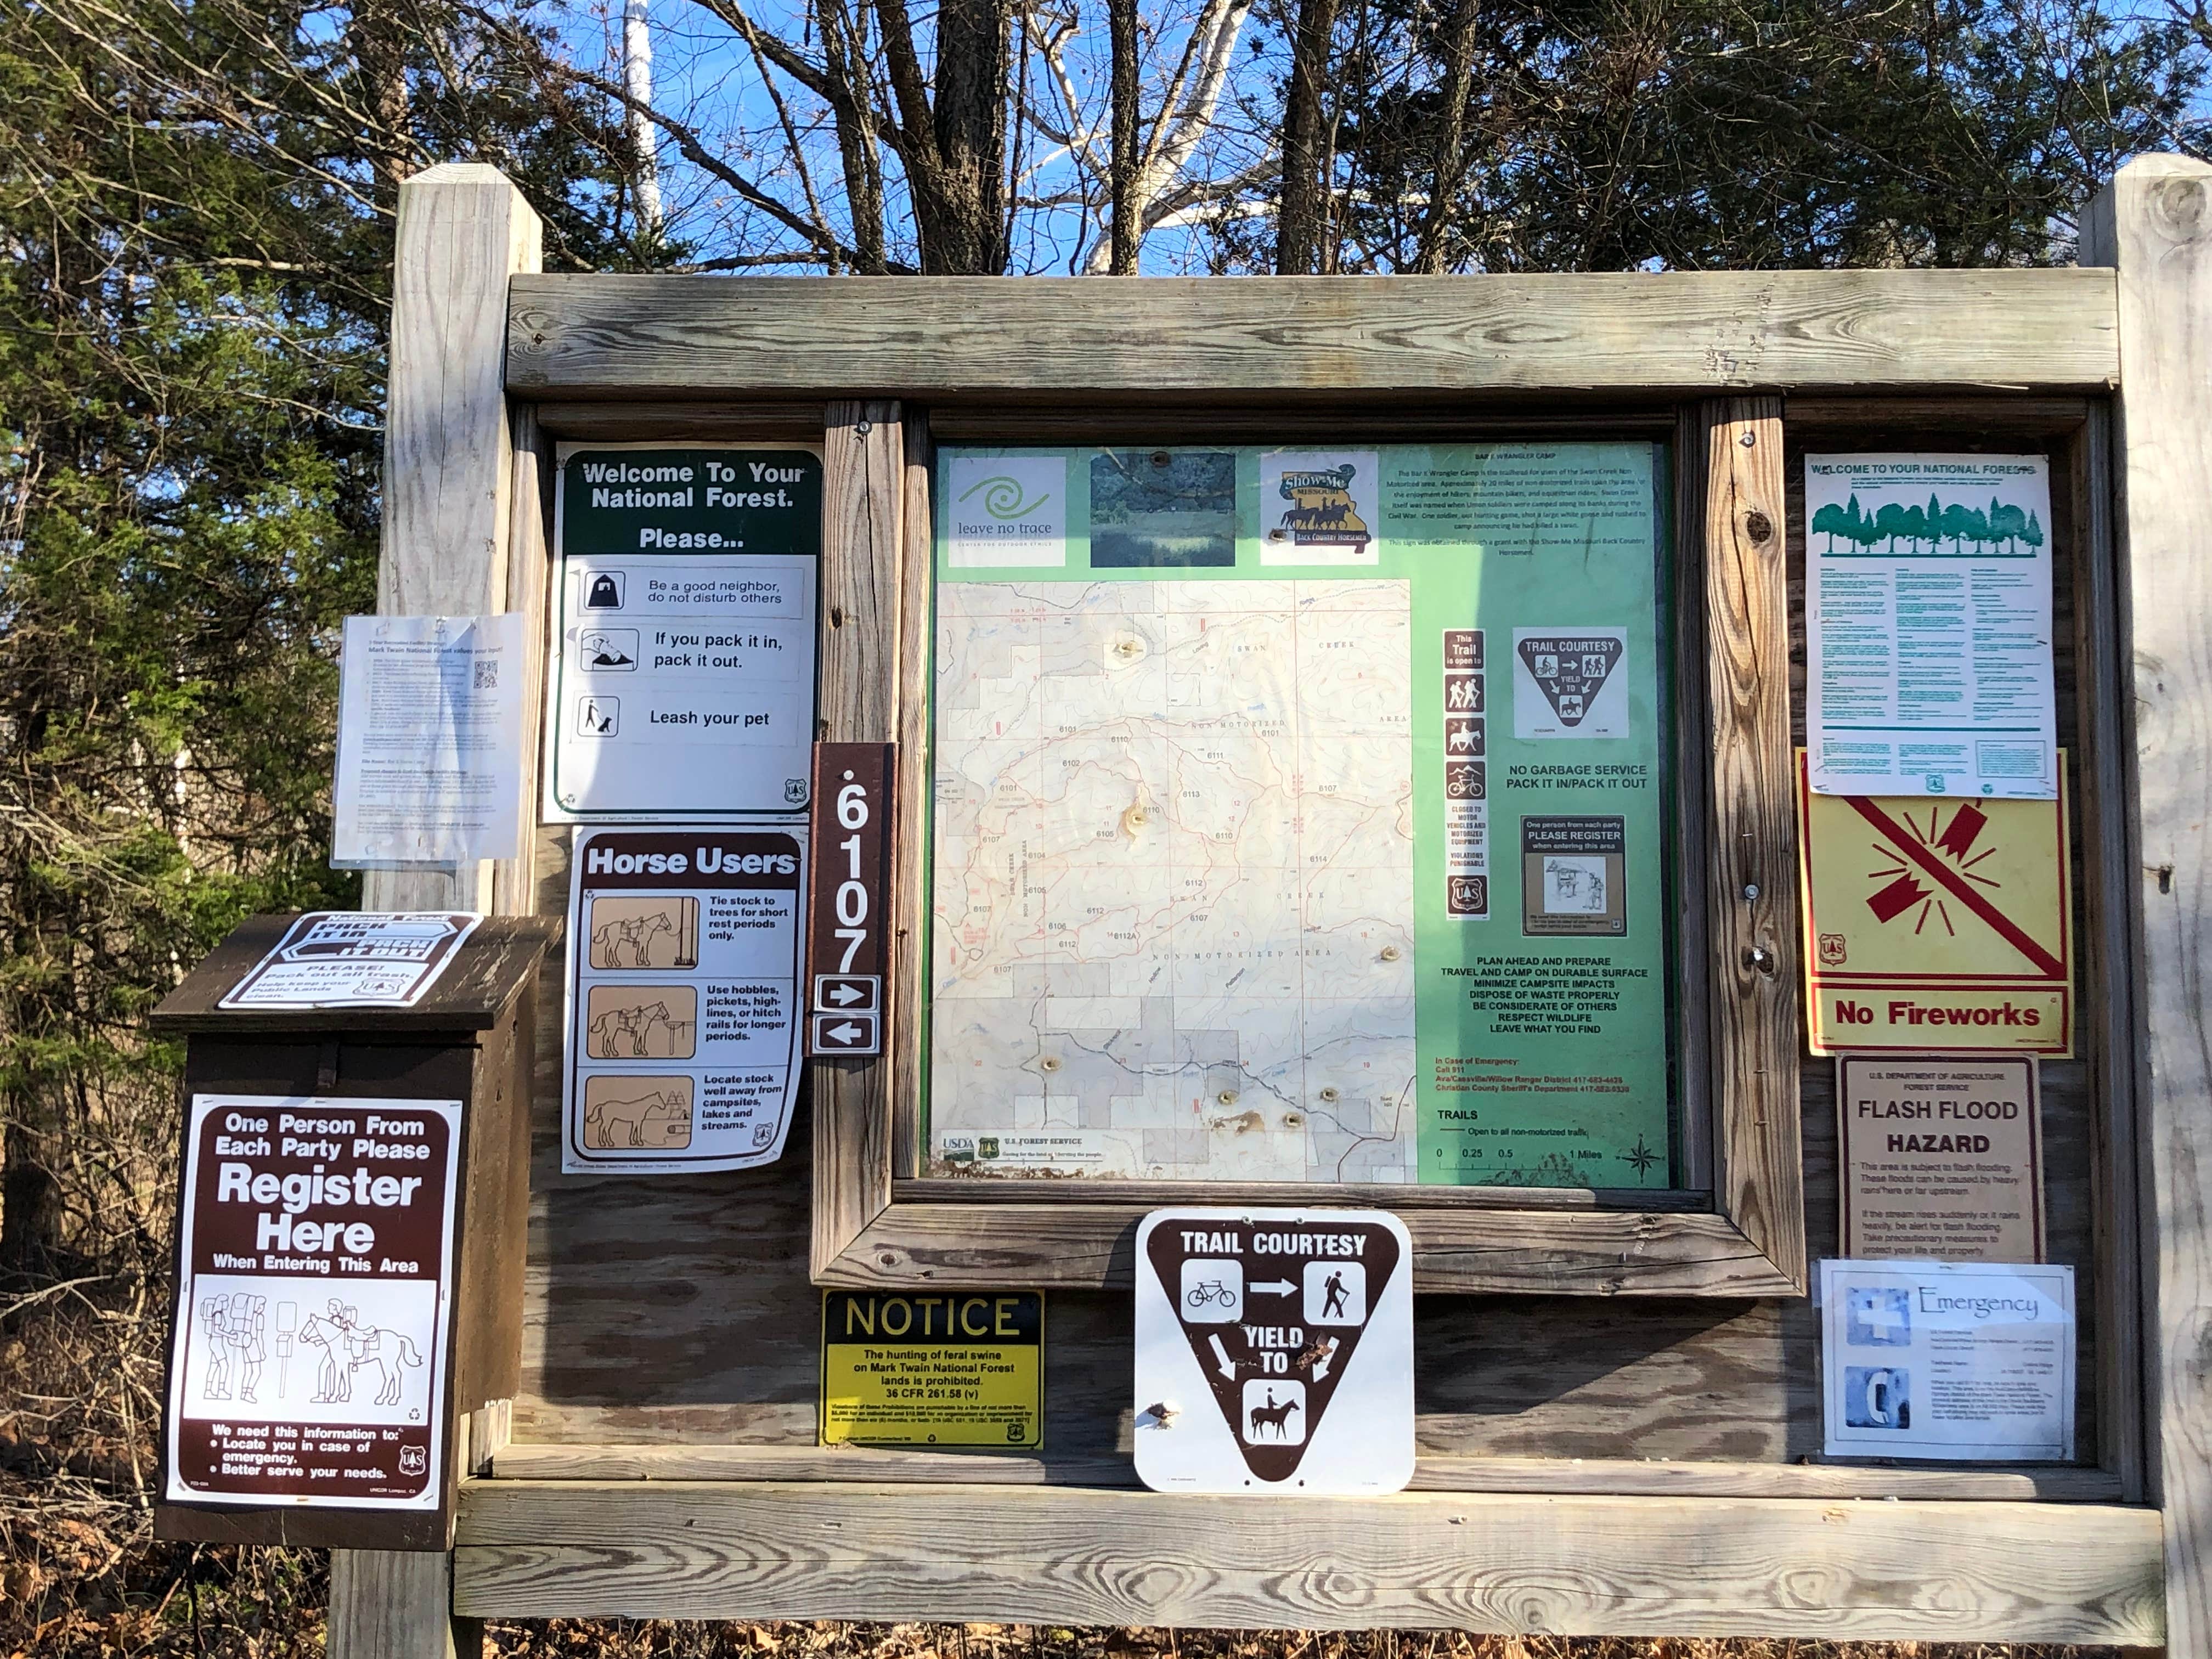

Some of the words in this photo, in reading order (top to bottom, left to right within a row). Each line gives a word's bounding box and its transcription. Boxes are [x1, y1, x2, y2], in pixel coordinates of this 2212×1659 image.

[584, 463, 693, 482] Welcome
[707, 463, 735, 481] To
[749, 463, 803, 482] Your
[1812, 465, 1869, 474] WELCOME
[1890, 465, 1920, 473] YOUR
[1924, 466, 1981, 474] NATIONAL
[592, 488, 693, 507] National
[707, 488, 793, 506] Forest.
[958, 522, 993, 533] leave
[997, 525, 1014, 533] no
[1019, 523, 1051, 533] trace
[640, 528, 743, 548] Please...
[650, 580, 667, 591] Be
[672, 583, 679, 591] a
[684, 581, 715, 593] good
[720, 581, 779, 593] neighbor,
[648, 592, 664, 603] do
[669, 594, 689, 603] not
[693, 593, 736, 603] disturb
[741, 593, 781, 603] others
[656, 633, 666, 645] If
[671, 636, 699, 648] you
[706, 634, 742, 648] pack
[749, 635, 758, 647] it
[764, 635, 782, 651] in,
[1526, 642, 1556, 652] TRAIL
[1559, 642, 1615, 652] COURTESY
[1453, 644, 1476, 654] Trail
[654, 654, 691, 668] pack
[697, 654, 707, 667] it
[713, 655, 742, 668] out.
[651, 711, 697, 724] Leash
[704, 713, 740, 727] your
[744, 713, 769, 727] pet
[1510, 765, 1527, 775] NO
[1531, 765, 1592, 775] GARBAGE
[1595, 765, 1646, 775] SERVICE
[1506, 779, 1539, 788] PACK
[1542, 779, 1553, 788] IT
[1556, 778, 1605, 788] IN/PACK
[1608, 779, 1618, 788] IT
[1622, 779, 1646, 788] OUT
[588, 848, 688, 874] Horse
[697, 848, 795, 874] Users
[835, 785, 868, 973] 6107
[710, 896, 726, 905] Tie
[730, 896, 761, 905] stock
[764, 897, 775, 905] to
[709, 909, 738, 917] trees
[742, 907, 756, 917] for
[759, 907, 788, 917] short
[709, 920, 731, 929] rest
[733, 919, 776, 930] periods
[708, 930, 734, 941] only.
[357, 939, 428, 947] PACK
[1542, 957, 1562, 966] AND
[1602, 969, 1648, 977] SURFACE
[1474, 979, 1517, 988] MINIMIZE
[1572, 980, 1615, 988] IMPACTS
[1568, 991, 1620, 1000] PROPERLY
[1836, 1001, 1874, 1024] No
[1888, 1002, 2040, 1026] Fireworks
[1438, 1110, 1477, 1120] TRAILS
[1859, 1101, 1931, 1118] FLASH
[1939, 1102, 2018, 1119] FLOOD
[225, 1114, 268, 1133] One
[279, 1114, 354, 1135] Person
[366, 1116, 424, 1136] From
[215, 1136, 270, 1156] Each
[281, 1139, 342, 1160] Party
[353, 1139, 430, 1159] Please
[944, 1138, 974, 1148] USDA
[1887, 1134, 1990, 1153] HAZARD
[1463, 1149, 1482, 1158] 0.25
[1498, 1149, 1513, 1158] 0.5
[218, 1163, 422, 1214] Register
[256, 1212, 375, 1254] Here
[1181, 1232, 1243, 1253] TRAIL
[1254, 1233, 1367, 1255] COURTESY
[213, 1254, 256, 1269] When
[264, 1255, 330, 1273] Entering
[338, 1256, 371, 1272] This
[380, 1258, 419, 1273] Area
[1918, 1286, 2038, 1320] Emergency
[847, 1298, 1019, 1336] NOTICE
[1245, 1327, 1303, 1347] YIELD
[864, 1350, 883, 1359] The
[887, 1350, 927, 1361] hunting
[931, 1350, 941, 1359] of
[944, 1351, 967, 1359] feral
[970, 1351, 1001, 1360] swine
[871, 1363, 896, 1372] Mark
[900, 1363, 930, 1372] Twain
[933, 1363, 977, 1373] National
[981, 1364, 1014, 1373] Forest
[1260, 1352, 1288, 1373] TO
[882, 1376, 910, 1385] lands
[914, 1376, 922, 1385] is
[926, 1376, 983, 1387] prohibited.
[887, 1390, 898, 1398] 36
[901, 1390, 924, 1398] CFR
[928, 1390, 961, 1398] 261.58
[965, 1390, 978, 1400] (v)
[213, 1425, 232, 1436] We
[237, 1425, 269, 1437] need
[275, 1426, 300, 1437] this
[304, 1426, 376, 1438] information
[383, 1429, 399, 1440] to:
[223, 1438, 266, 1451] Locate
[273, 1441, 296, 1454] you
[302, 1440, 314, 1451] in
[320, 1442, 351, 1452] case
[356, 1441, 370, 1452] of
[223, 1452, 297, 1464] emergency.
[222, 1464, 261, 1475] Better
[268, 1466, 303, 1476] serve
[311, 1468, 338, 1480] your
[344, 1466, 387, 1479] needs.
